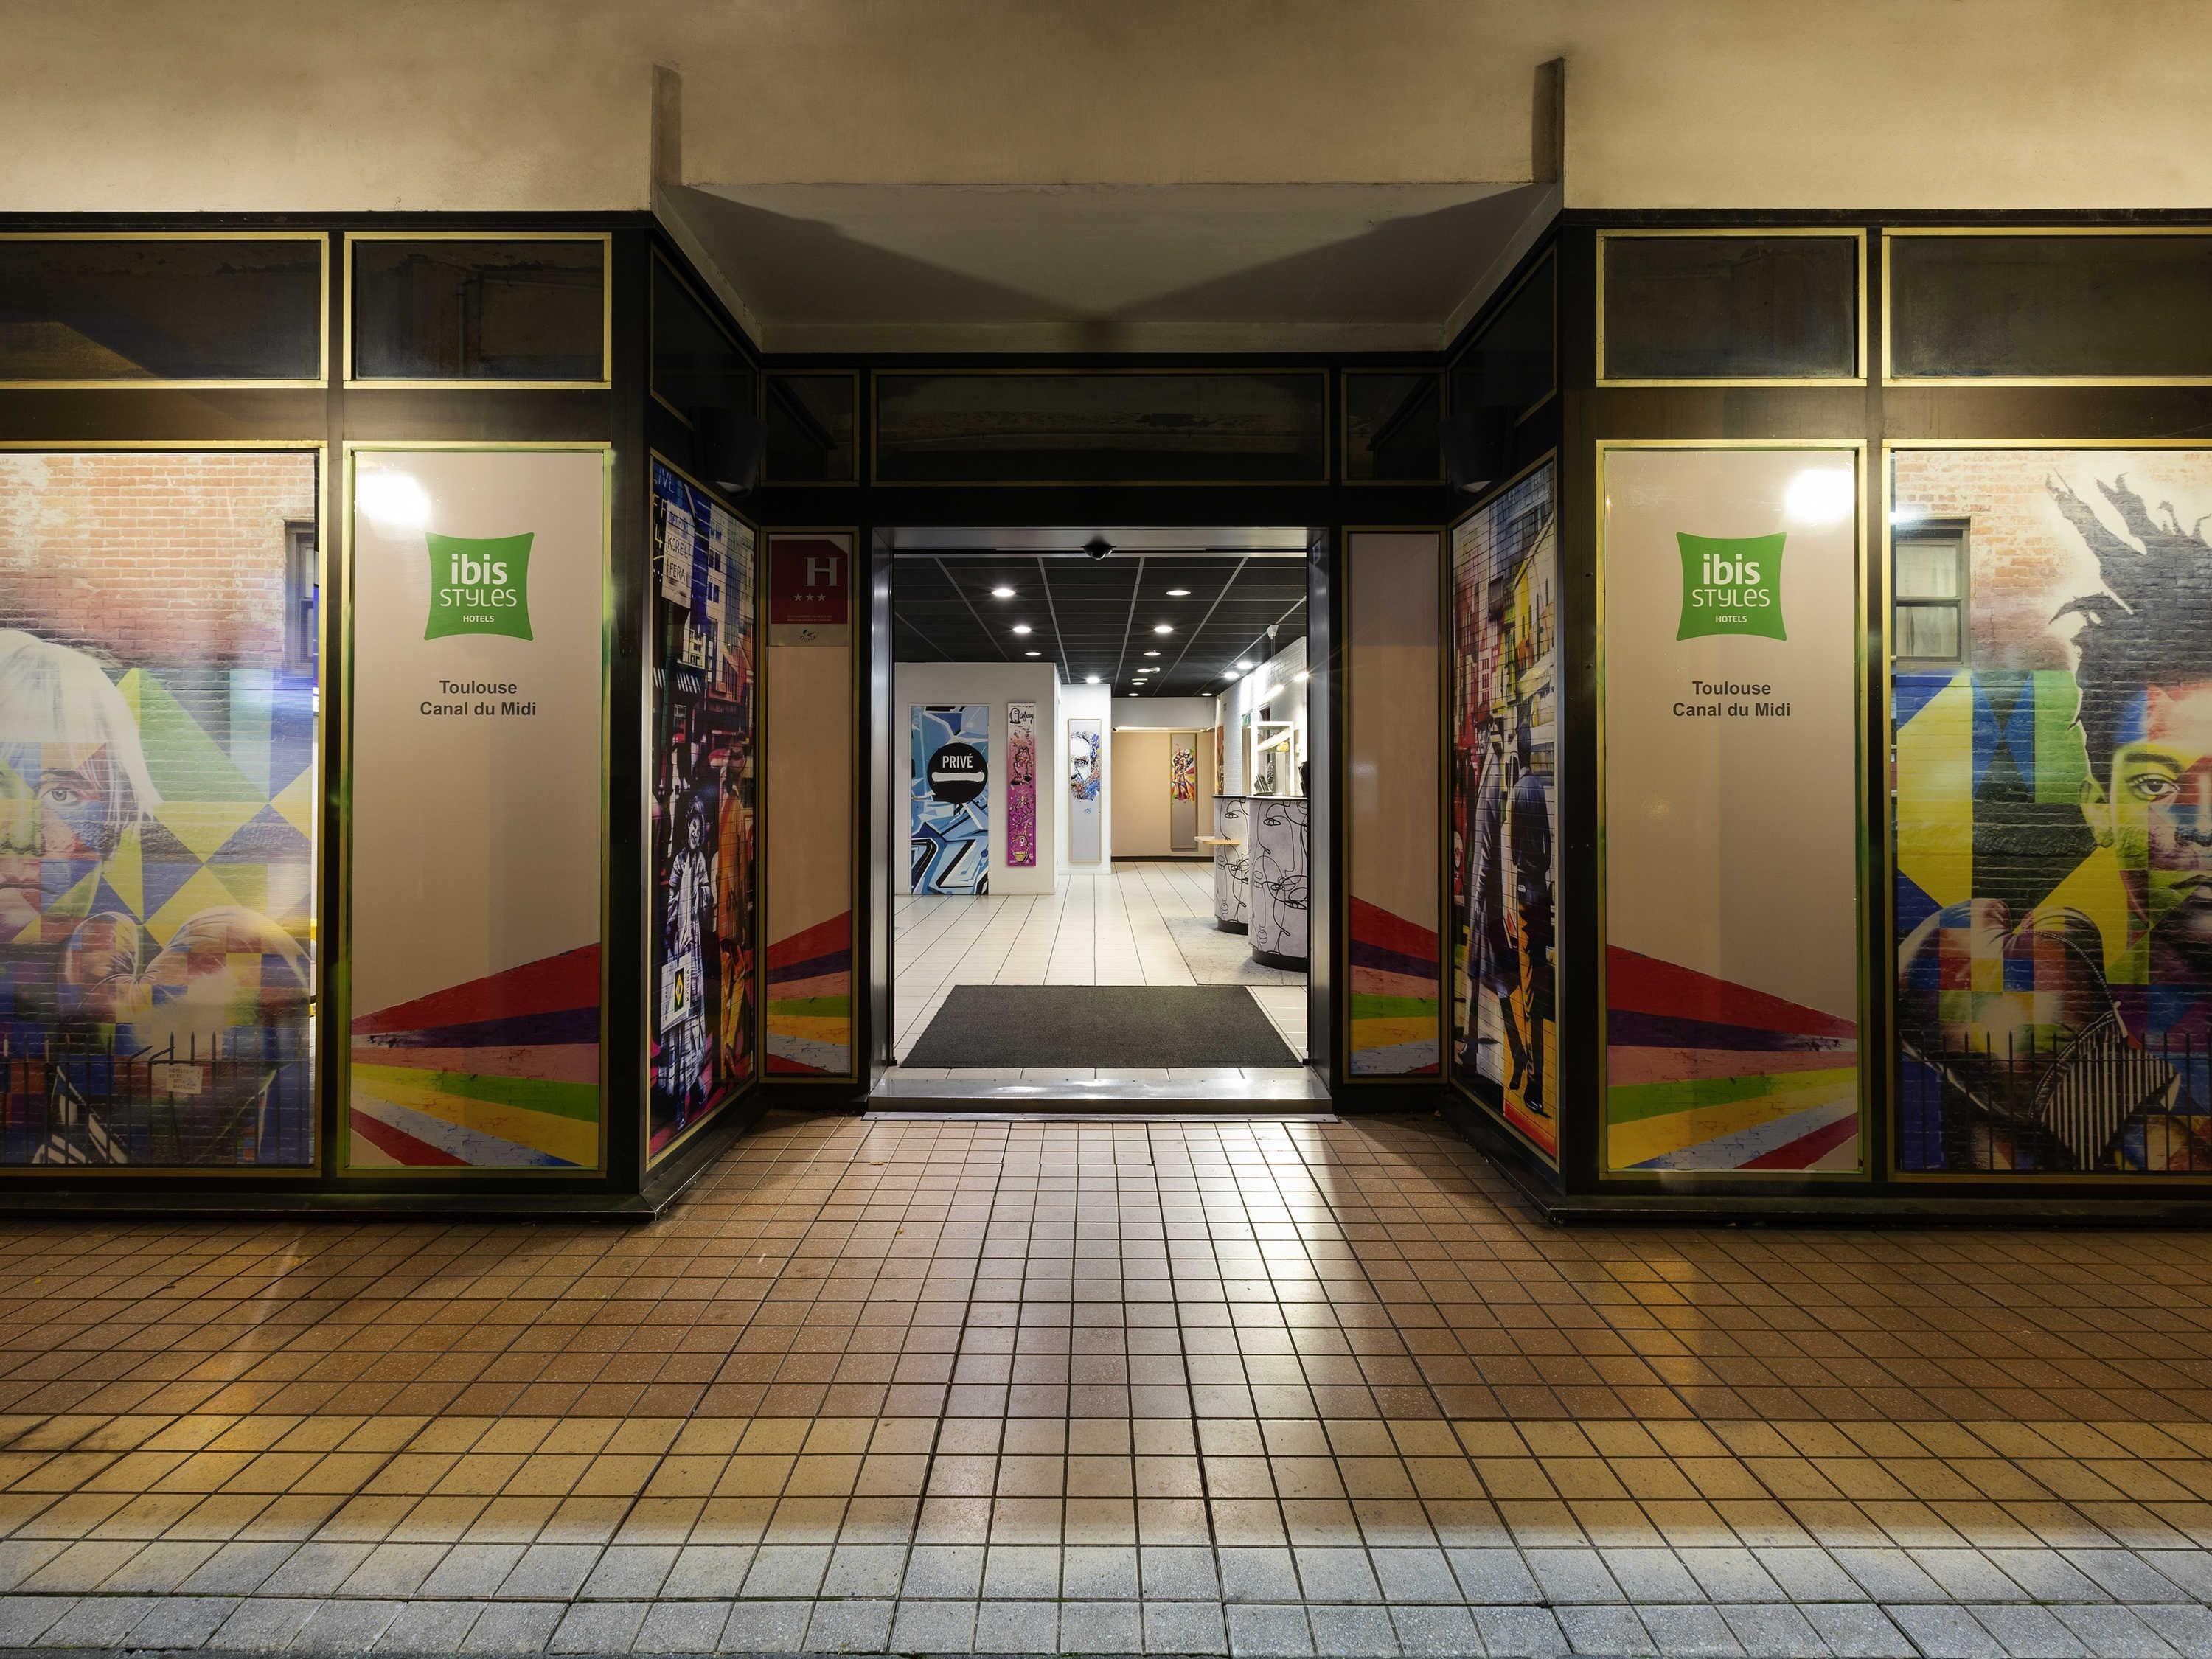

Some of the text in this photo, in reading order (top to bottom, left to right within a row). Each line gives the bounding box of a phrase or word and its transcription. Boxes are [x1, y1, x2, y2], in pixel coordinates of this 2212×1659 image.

[451, 554, 508, 585] ibis
[804, 557, 841, 587] H
[1703, 554, 1761, 585] ibis
[462, 615, 495, 623] HOTELS
[1715, 615, 1747, 623] HOTELS
[439, 680, 518, 694] Toulouse
[1691, 681, 1772, 695] Toulouse
[420, 701, 537, 716] Canal du Midi
[1672, 702, 1791, 717] Canal du Midi
[942, 753, 973, 769] PRIVÉ
